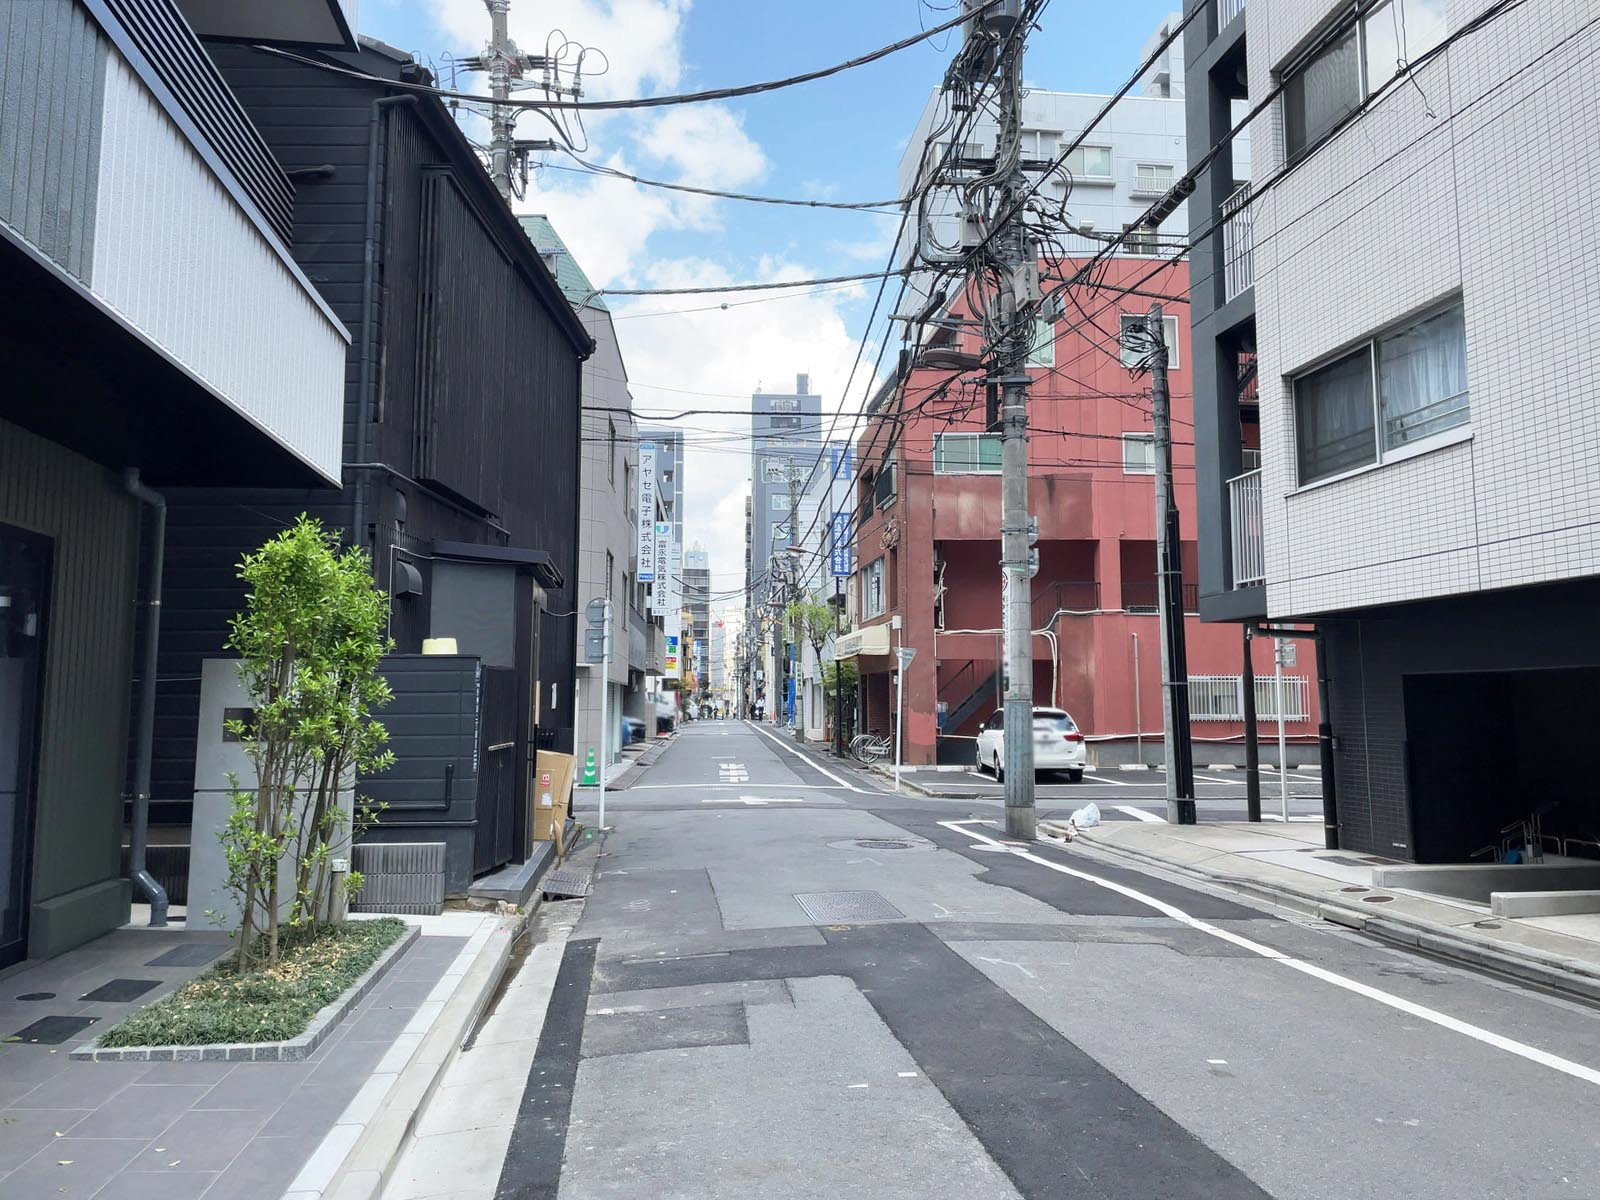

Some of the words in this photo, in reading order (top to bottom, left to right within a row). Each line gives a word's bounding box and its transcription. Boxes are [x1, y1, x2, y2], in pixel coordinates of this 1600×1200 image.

[641, 454, 652, 568] アヤセ電子株式会社
